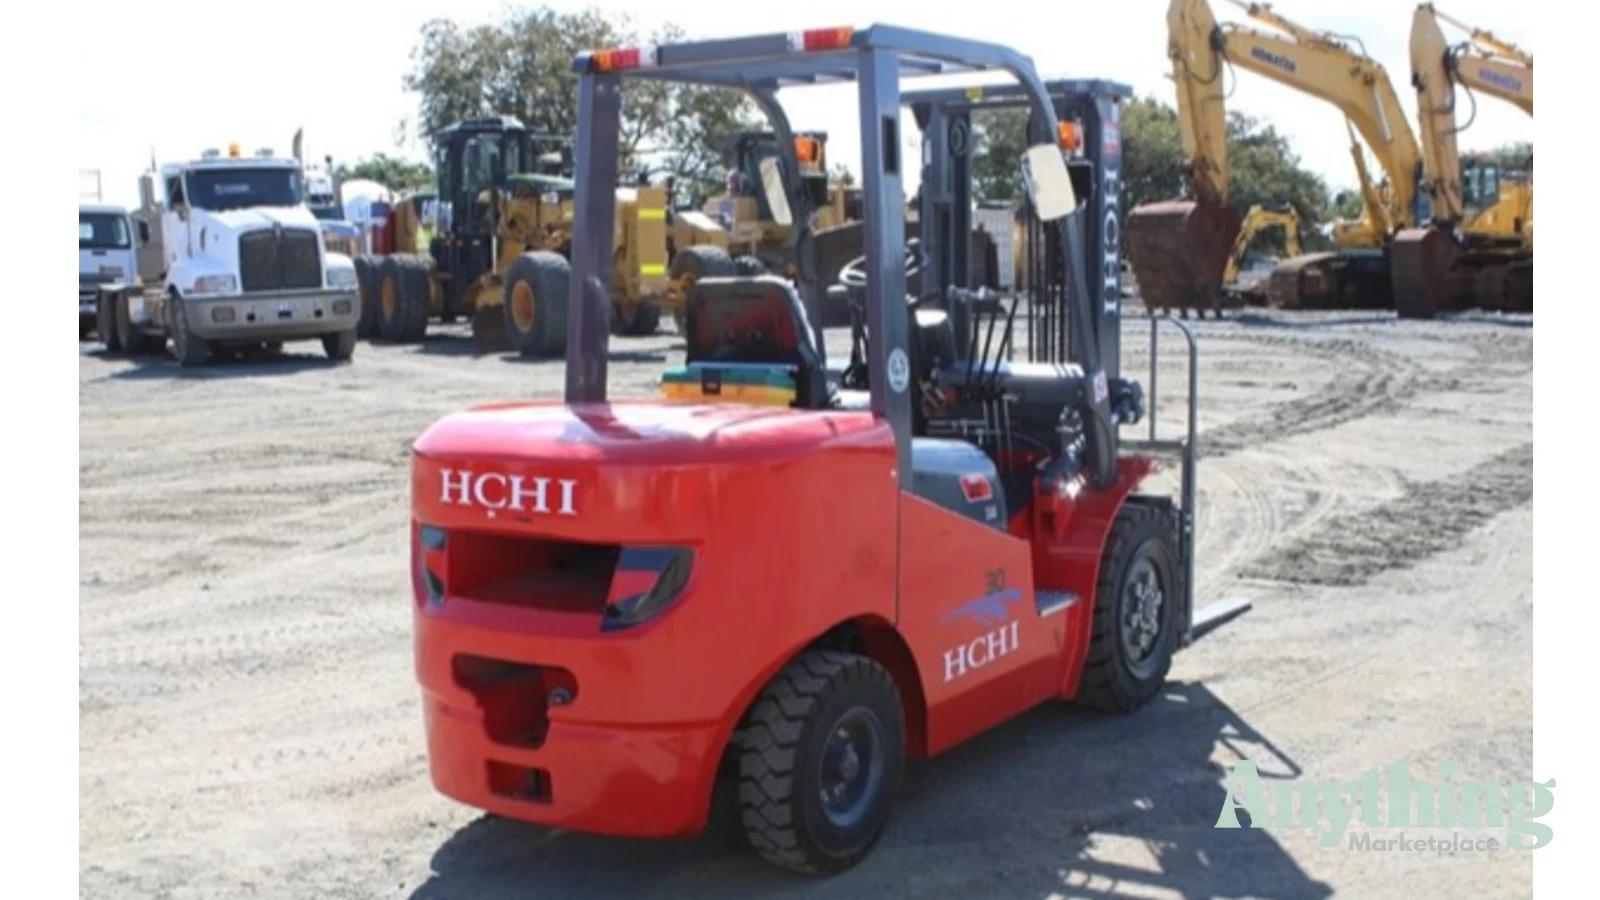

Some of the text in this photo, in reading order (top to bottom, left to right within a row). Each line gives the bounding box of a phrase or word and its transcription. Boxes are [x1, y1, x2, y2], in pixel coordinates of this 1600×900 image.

[1104, 168, 1118, 314] HCHI
[440, 467, 578, 515] HCHI
[943, 620, 1019, 683] HCHI
